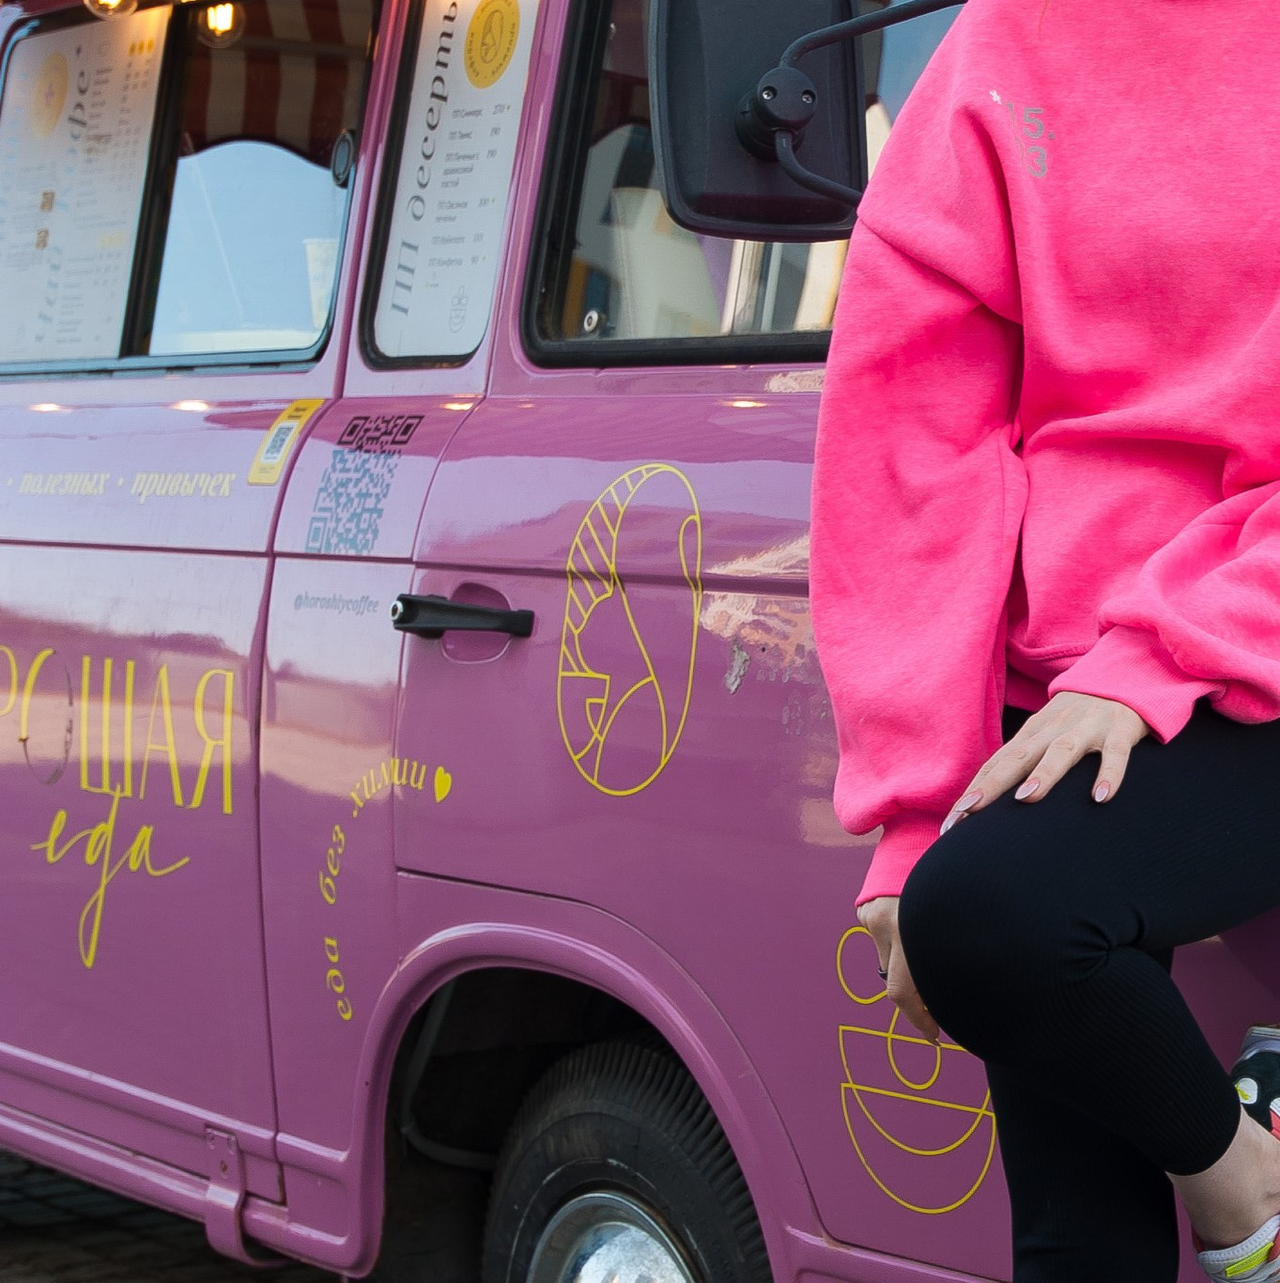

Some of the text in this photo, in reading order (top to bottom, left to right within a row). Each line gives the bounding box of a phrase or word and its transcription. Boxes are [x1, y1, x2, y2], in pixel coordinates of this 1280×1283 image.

[390, 240, 420, 316] ПП
[17, 471, 237, 505] полезных привычек
[30, 783, 190, 969] еда
[318, 756, 427, 1022] еда без химии
